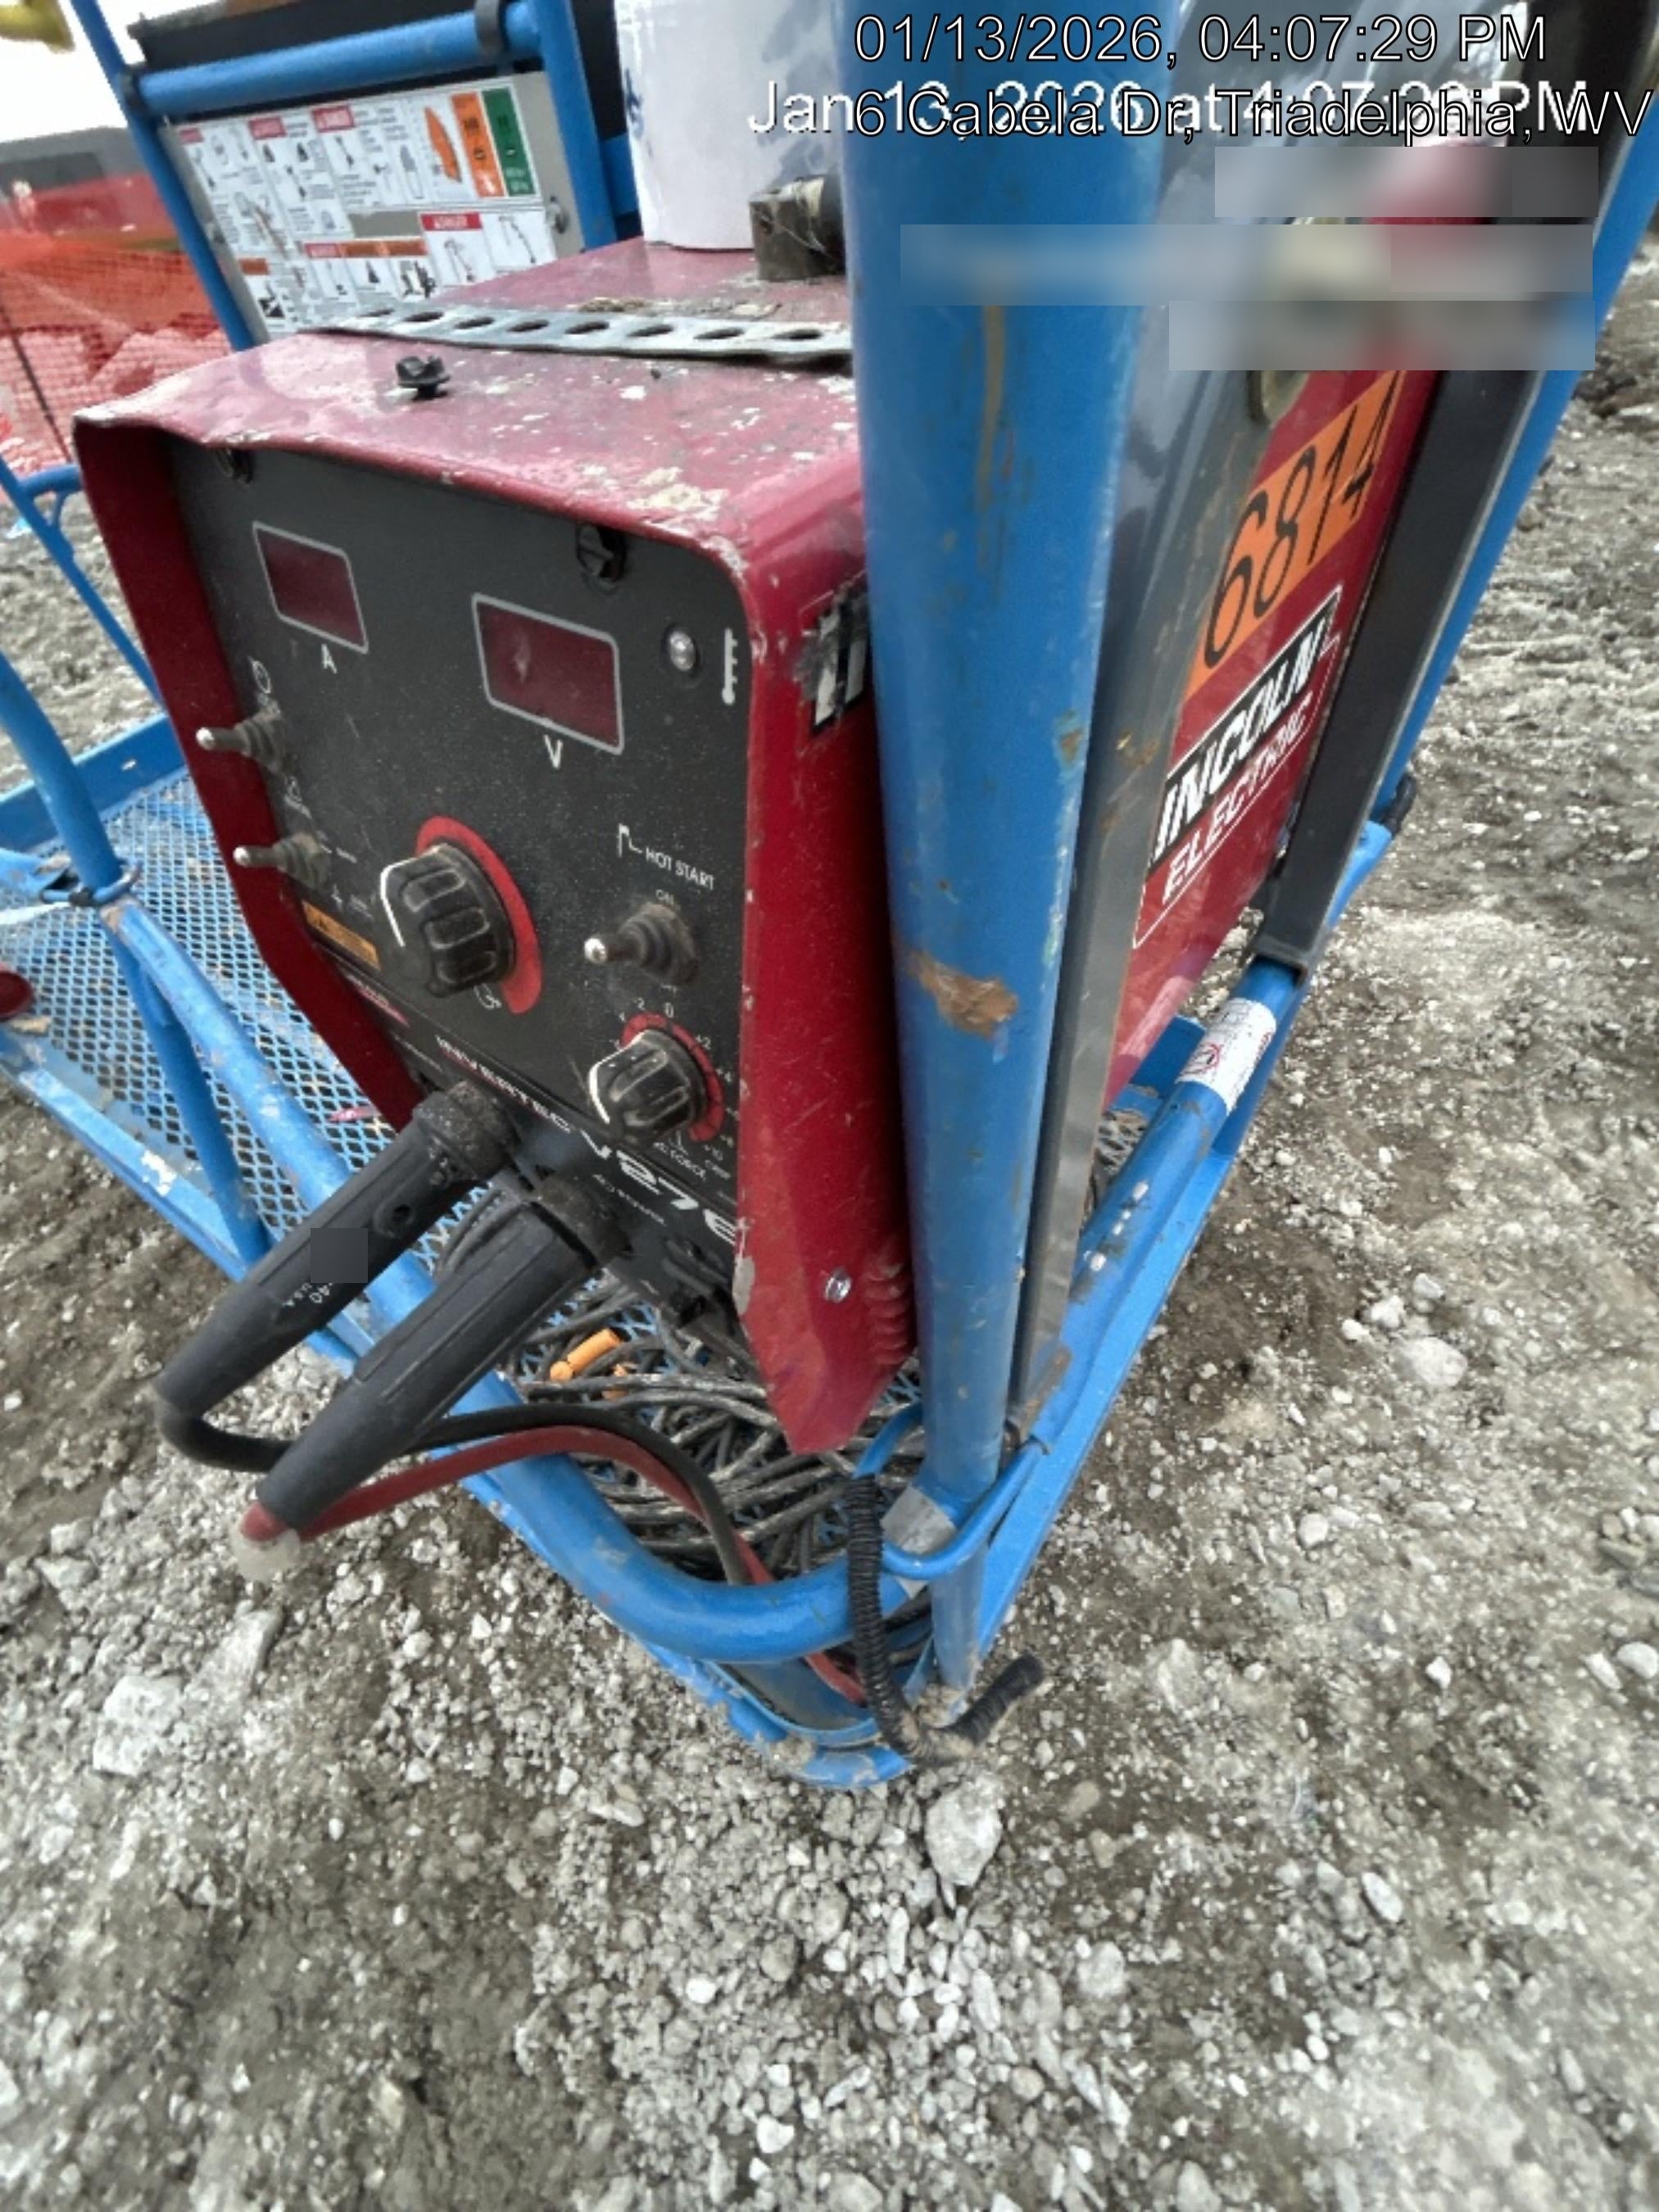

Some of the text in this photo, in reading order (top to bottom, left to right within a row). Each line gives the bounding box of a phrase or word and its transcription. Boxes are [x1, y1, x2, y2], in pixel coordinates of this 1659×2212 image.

[1203, 370, 1400, 669] 6814
[320, 643, 338, 674] A
[542, 733, 564, 769] V
[1147, 616, 1327, 868] INCOLN
[645, 845, 715, 891] HOT START
